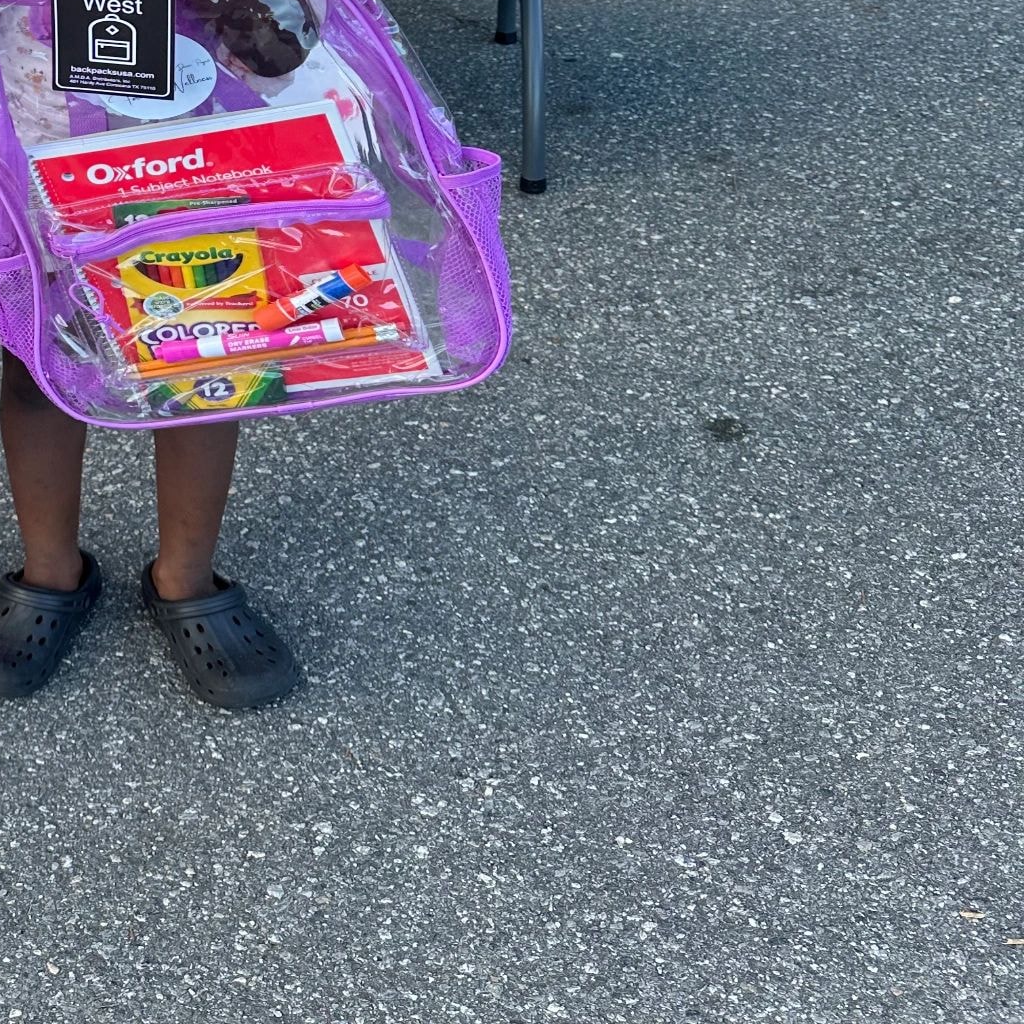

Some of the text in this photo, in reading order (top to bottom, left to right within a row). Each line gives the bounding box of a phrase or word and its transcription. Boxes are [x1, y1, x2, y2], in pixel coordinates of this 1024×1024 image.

[70, 65, 155, 79] backpacksusa.com
[86, 148, 205, 185] Oxford
[118, 164, 273, 197] 1 Subject Notebook
[139, 247, 234, 264] Crayola
[339, 294, 369, 309] 70
[229, 343, 268, 352] MARKERS
[244, 337, 270, 346] ERASE
[201, 382, 229, 396] 12
